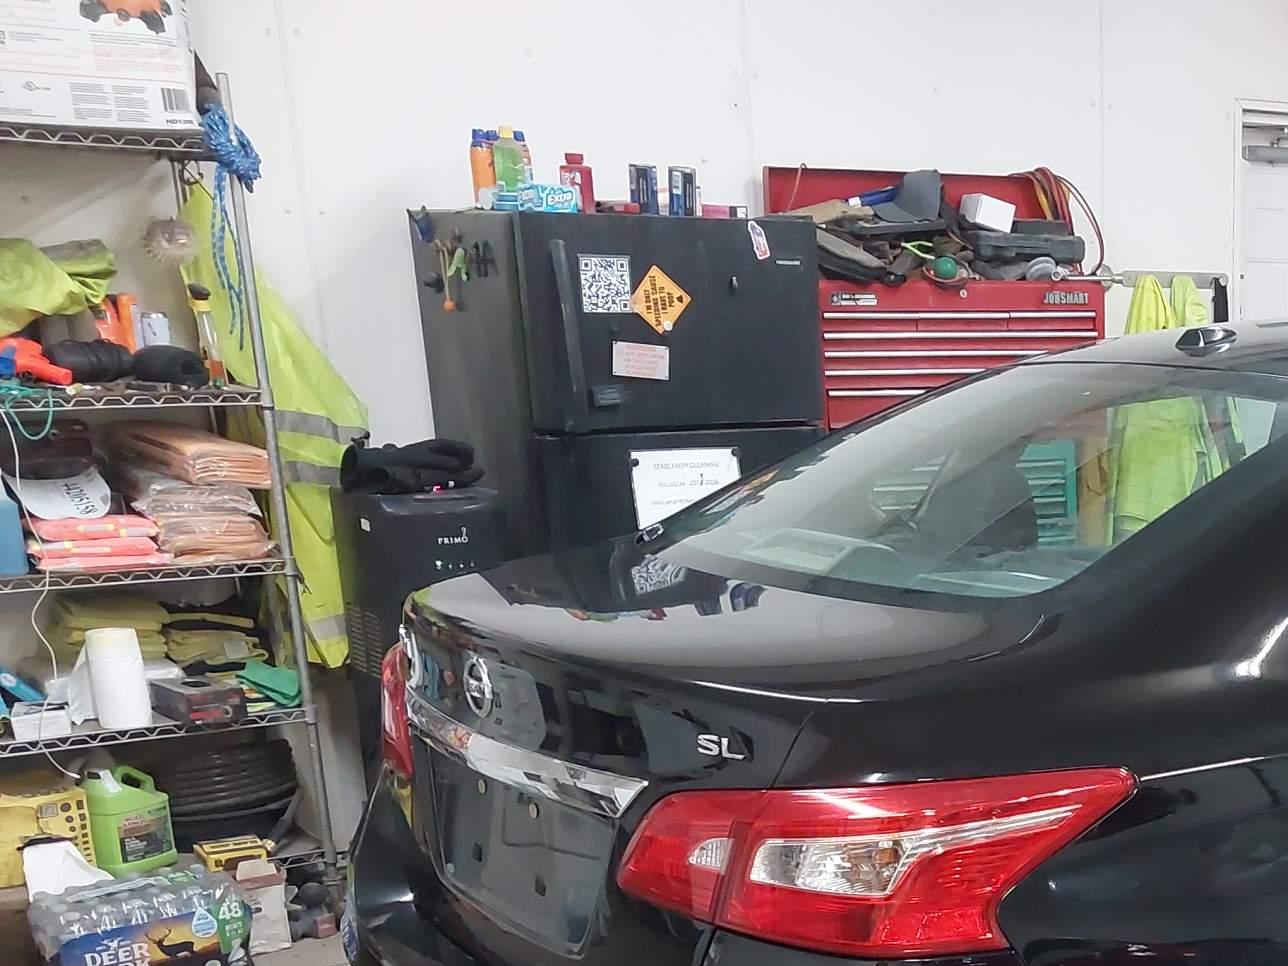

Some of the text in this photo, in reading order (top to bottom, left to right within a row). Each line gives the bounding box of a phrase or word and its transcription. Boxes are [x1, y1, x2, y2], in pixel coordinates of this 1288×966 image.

[1043, 291, 1089, 305] JOBSMART
[437, 526, 469, 545] PRIMO
[697, 734, 746, 760] SL
[218, 902, 242, 920] 48
